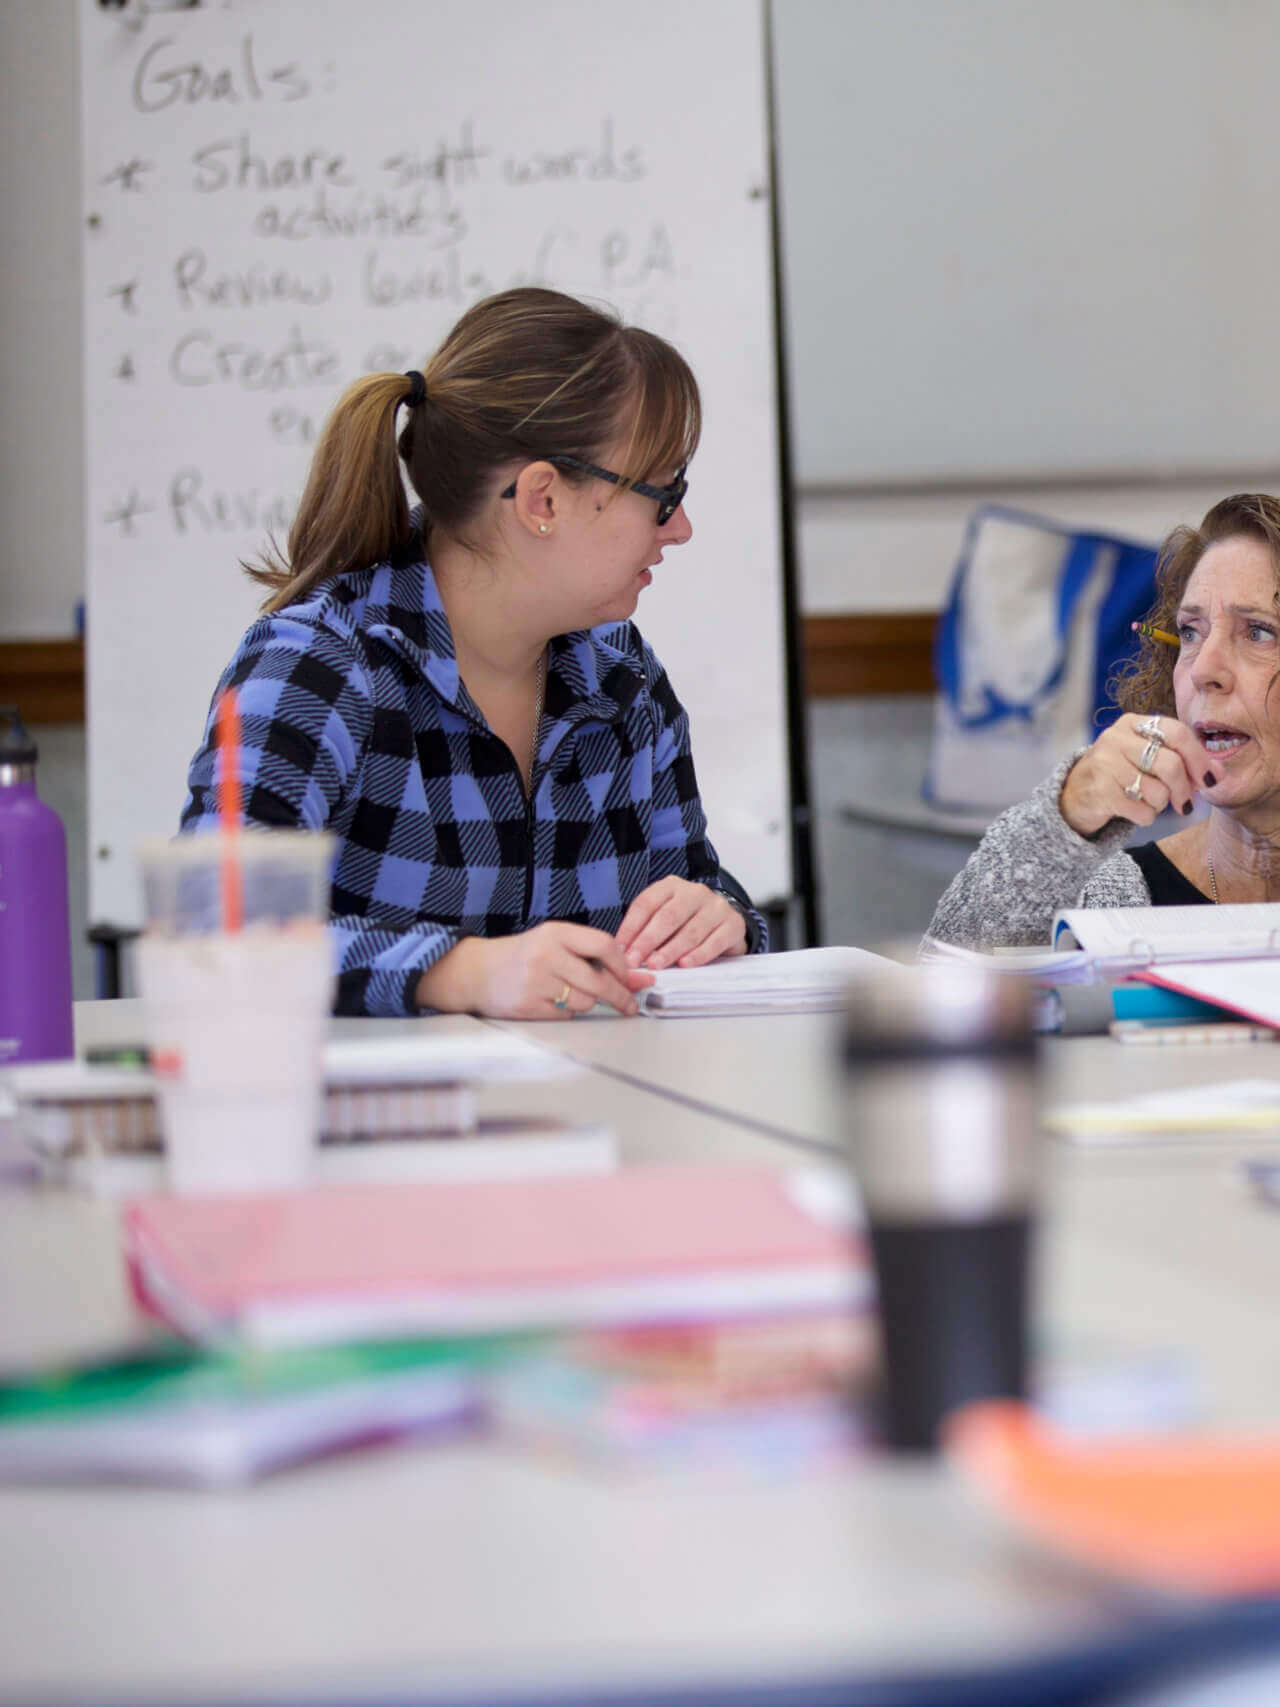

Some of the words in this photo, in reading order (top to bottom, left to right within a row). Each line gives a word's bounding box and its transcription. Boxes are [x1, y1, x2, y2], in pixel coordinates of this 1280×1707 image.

[132, 33, 338, 113] Goals:
[190, 130, 356, 194] Share
[503, 117, 648, 184] words
[173, 248, 334, 310] Review
[168, 326, 340, 392] Create
